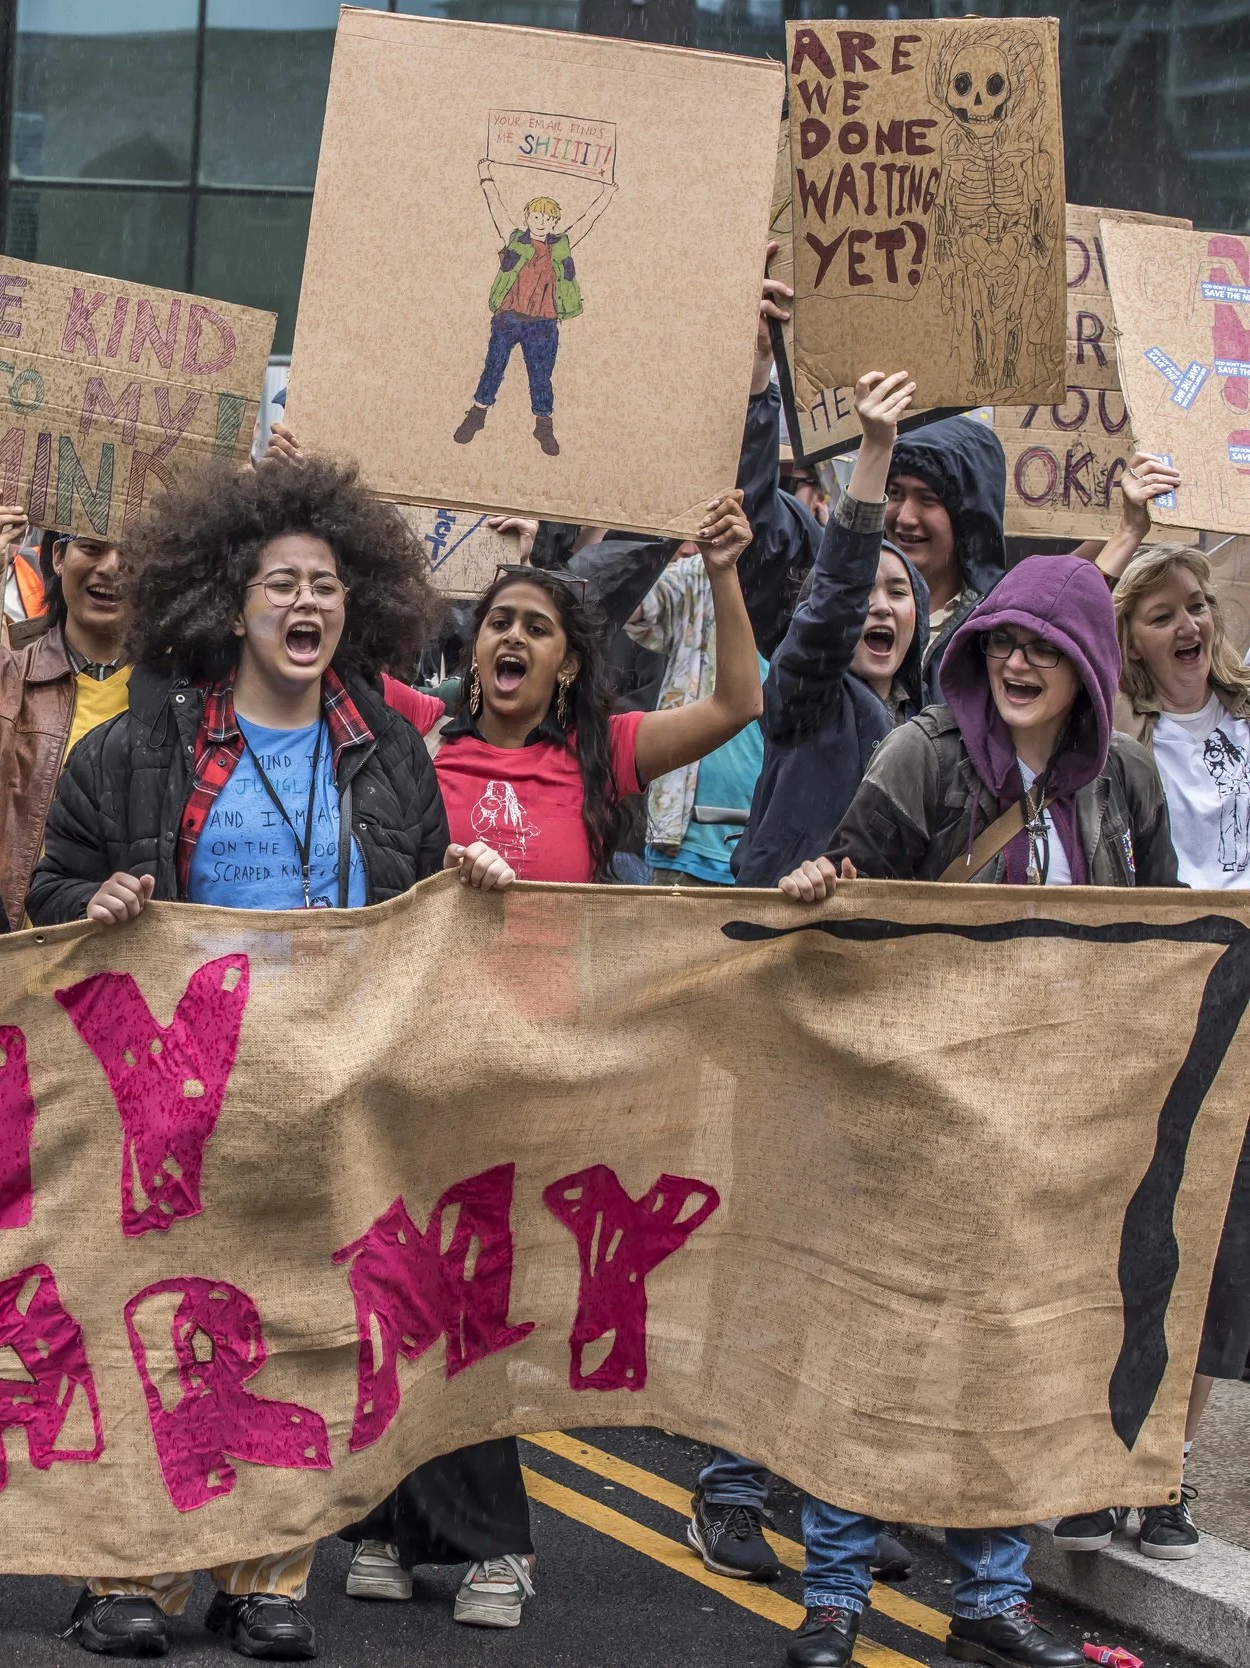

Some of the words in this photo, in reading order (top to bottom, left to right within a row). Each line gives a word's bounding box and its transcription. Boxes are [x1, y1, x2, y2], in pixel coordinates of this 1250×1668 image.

[791, 28, 922, 79] ARE
[797, 80, 870, 116] WE
[494, 115, 521, 127] YOUR
[528, 119, 562, 132] EMAIL
[570, 123, 606, 139] FINDS
[496, 132, 514, 144] ME
[800, 118, 938, 160] DONE
[796, 162, 941, 224] WAITING
[803, 220, 927, 289] YET?
[1204, 288, 1225, 298] SAVE
[1226, 292, 1241, 300] THE
[61, 287, 236, 375] KIND
[1217, 366, 1238, 376] SAVE
[79, 377, 202, 461] MY
[1014, 446, 1128, 511] OKA
[209, 809, 244, 830] AND
[260, 811, 277, 828] I
[212, 841, 237, 856] ON
[244, 841, 280, 856] THE
[211, 861, 270, 883] SCRAPED
[281, 866, 326, 878] KNE,
